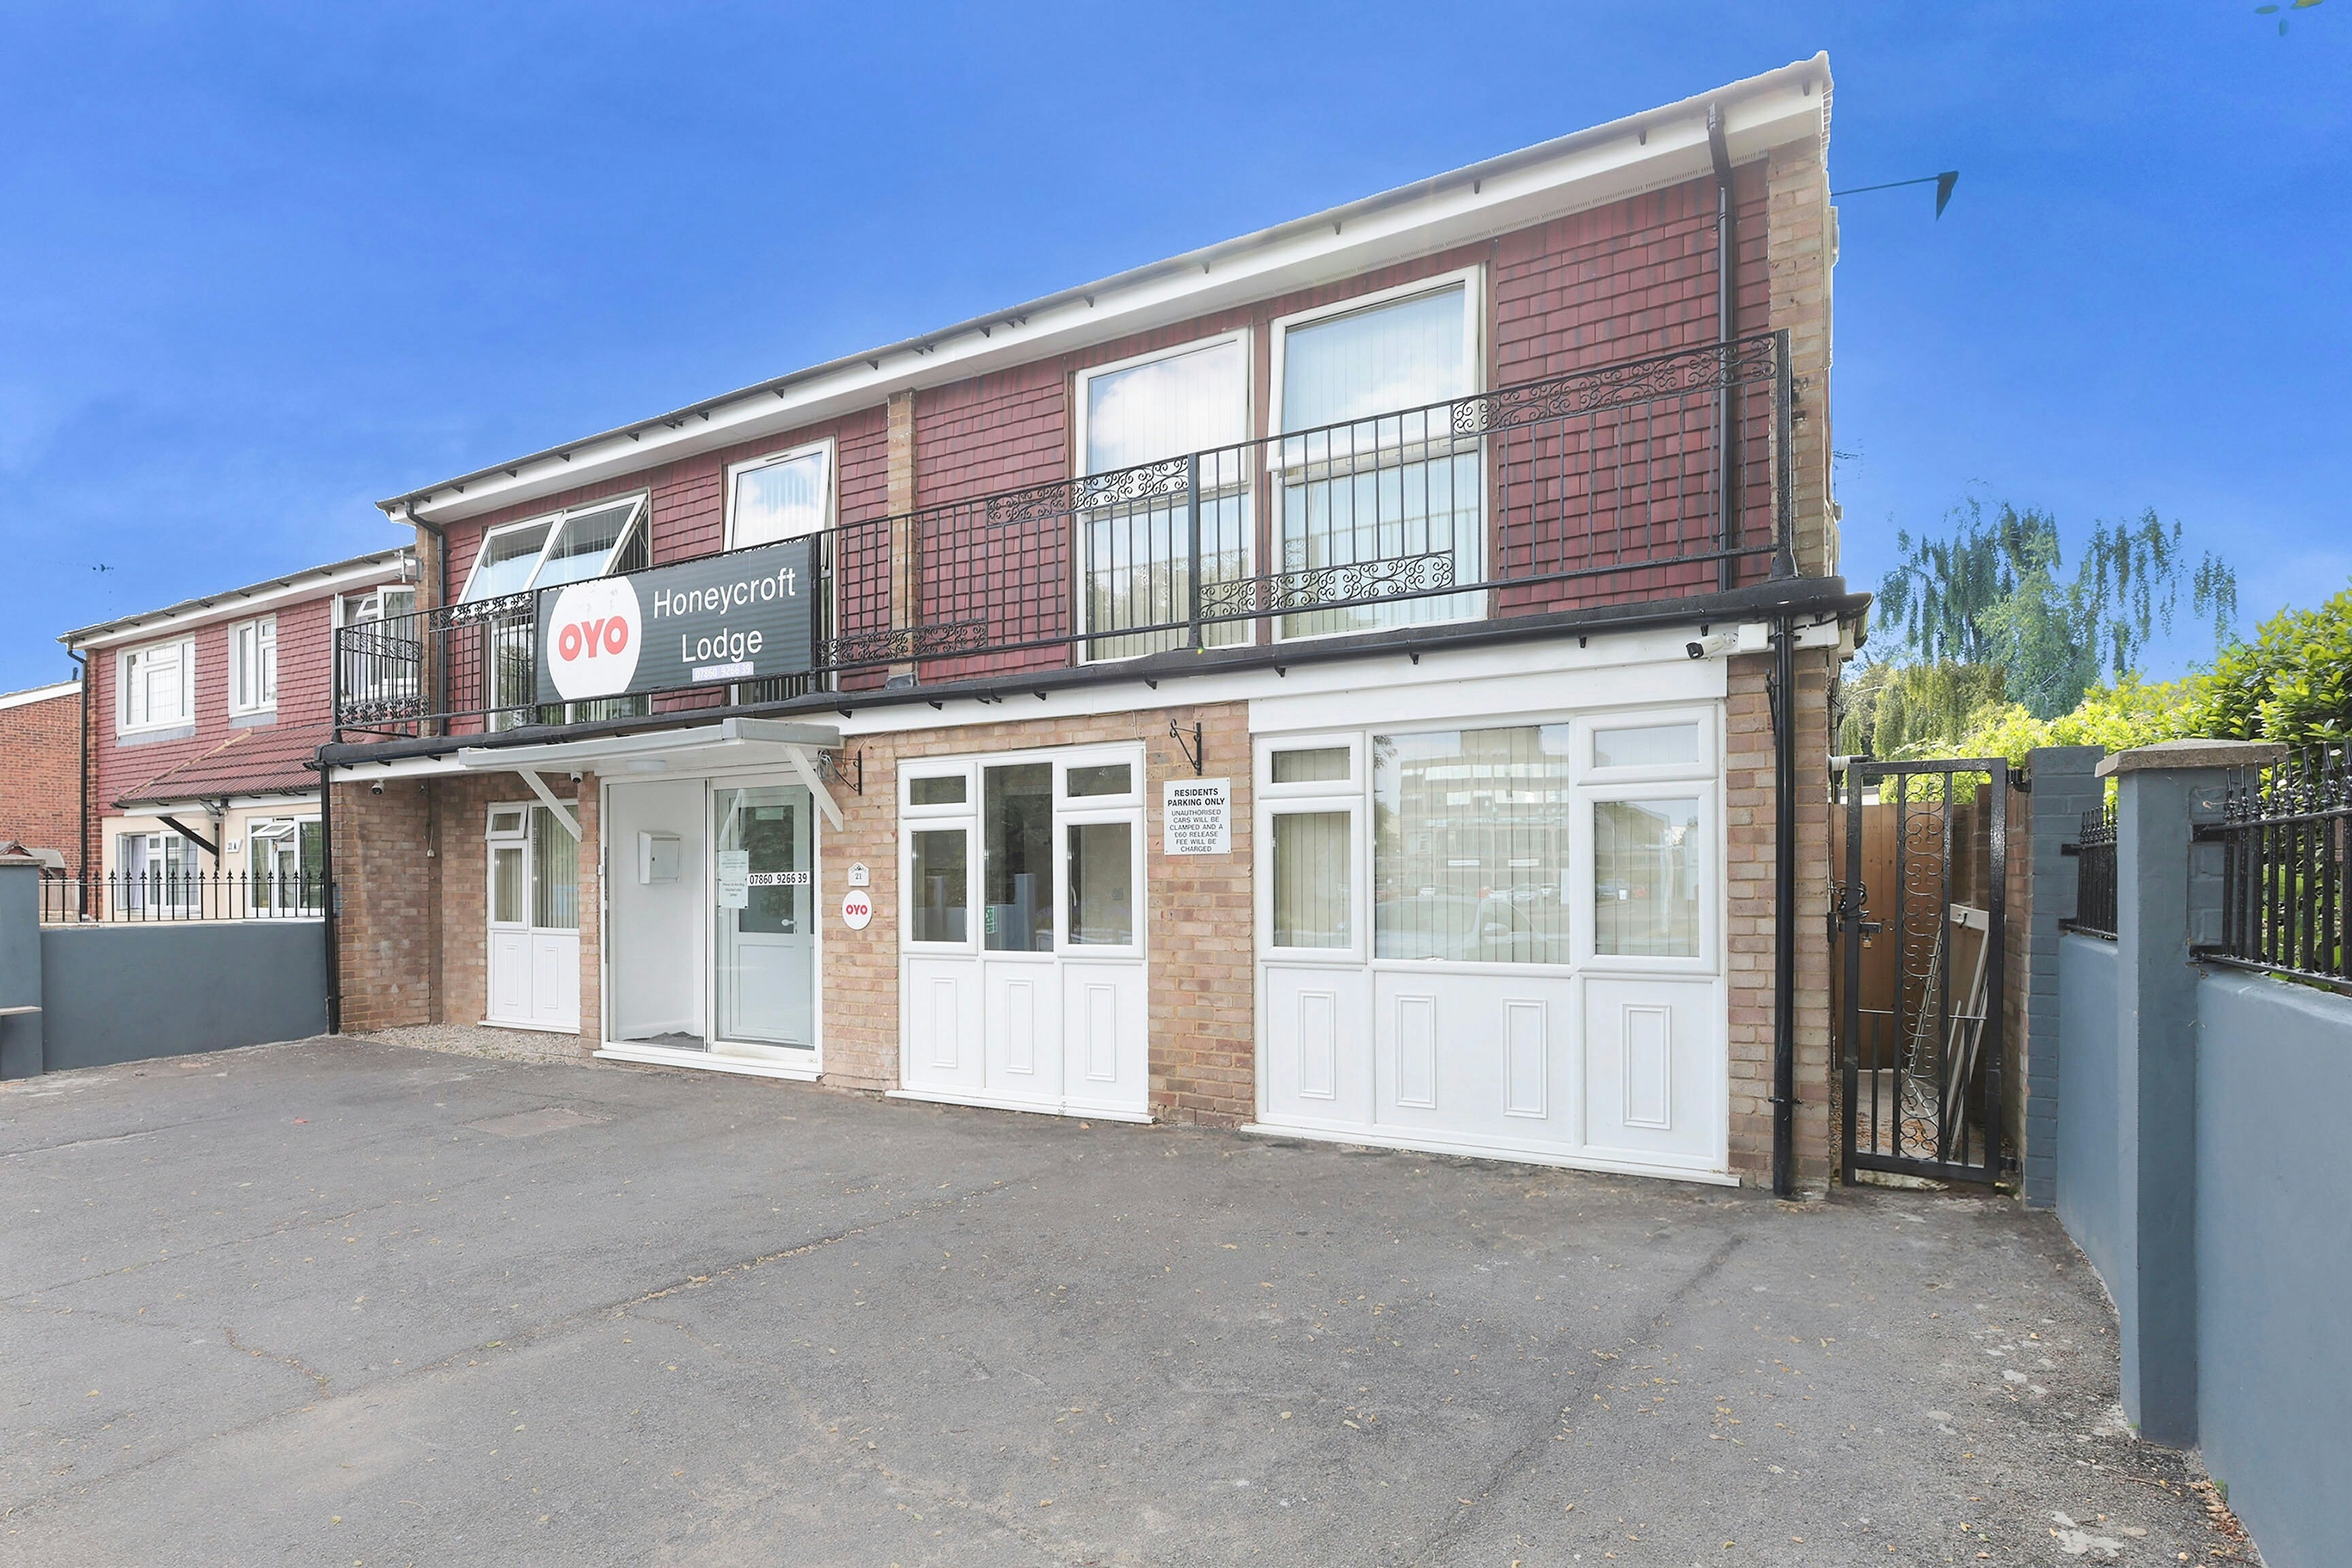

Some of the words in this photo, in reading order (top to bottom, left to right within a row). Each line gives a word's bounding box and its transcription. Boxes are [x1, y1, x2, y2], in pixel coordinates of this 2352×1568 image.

[653, 567, 796, 619] Honeycroft
[558, 615, 628, 662] OYO
[682, 627, 763, 663] Lodge
[695, 667, 717, 679] 07860
[721, 664, 740, 676] 9266
[742, 664, 751, 674] 39
[1174, 788, 1218, 797] RESIDENTS
[1167, 798, 1201, 806] PARKING
[1205, 798, 1225, 806] ONLY
[749, 875, 773, 884] 07860
[777, 873, 796, 883] 9266
[798, 873, 807, 883] 39
[846, 904, 868, 915] OYO
